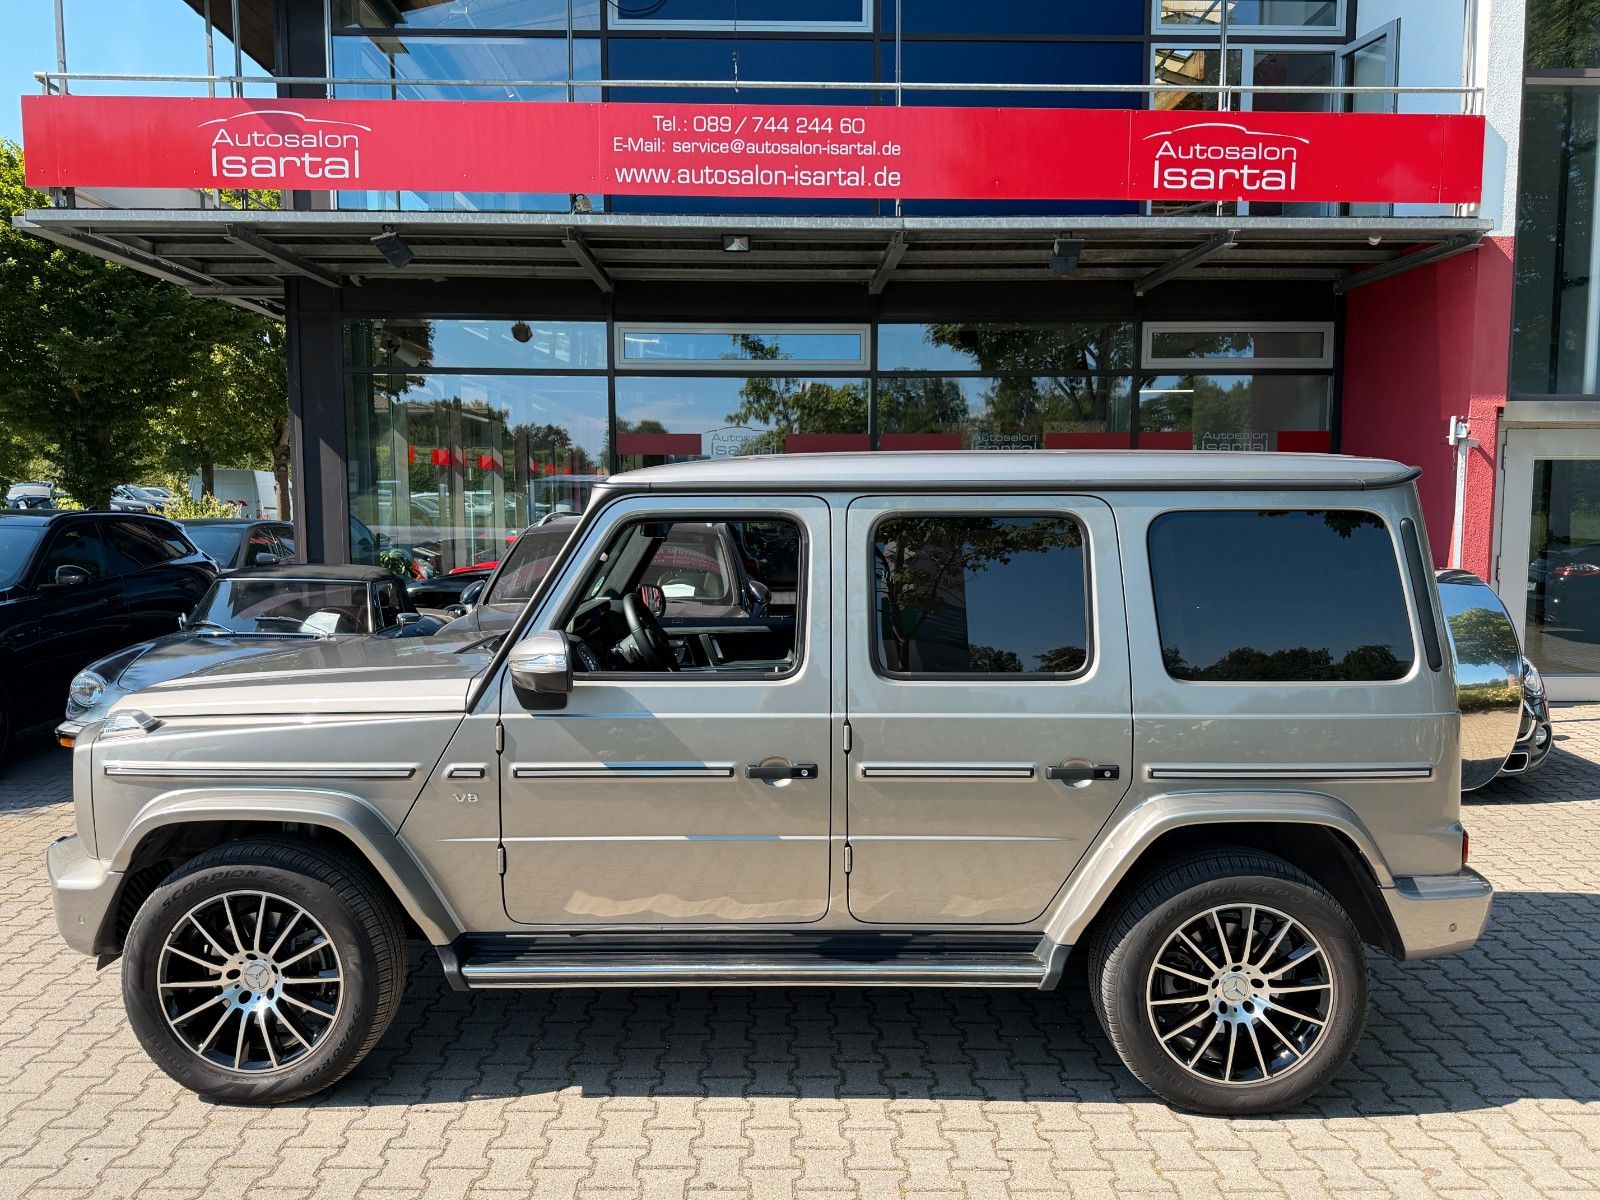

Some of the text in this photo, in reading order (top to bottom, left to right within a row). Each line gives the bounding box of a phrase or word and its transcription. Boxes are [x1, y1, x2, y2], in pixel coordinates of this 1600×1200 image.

[653, 115, 687, 132] Tel.:
[796, 118, 833, 134] 244
[840, 118, 865, 134] 60
[211, 128, 359, 149] Autosalon
[613, 137, 901, 156] E-Mail: service@autosalon-isartal.de
[1155, 140, 1297, 160] Autosalon
[211, 148, 360, 179] Isartal
[614, 164, 901, 187] www.autosalon-isartal.de
[1153, 160, 1296, 191] Isartal
[711, 441, 777, 456] Isatal
[161, 868, 259, 911] SCORPION
